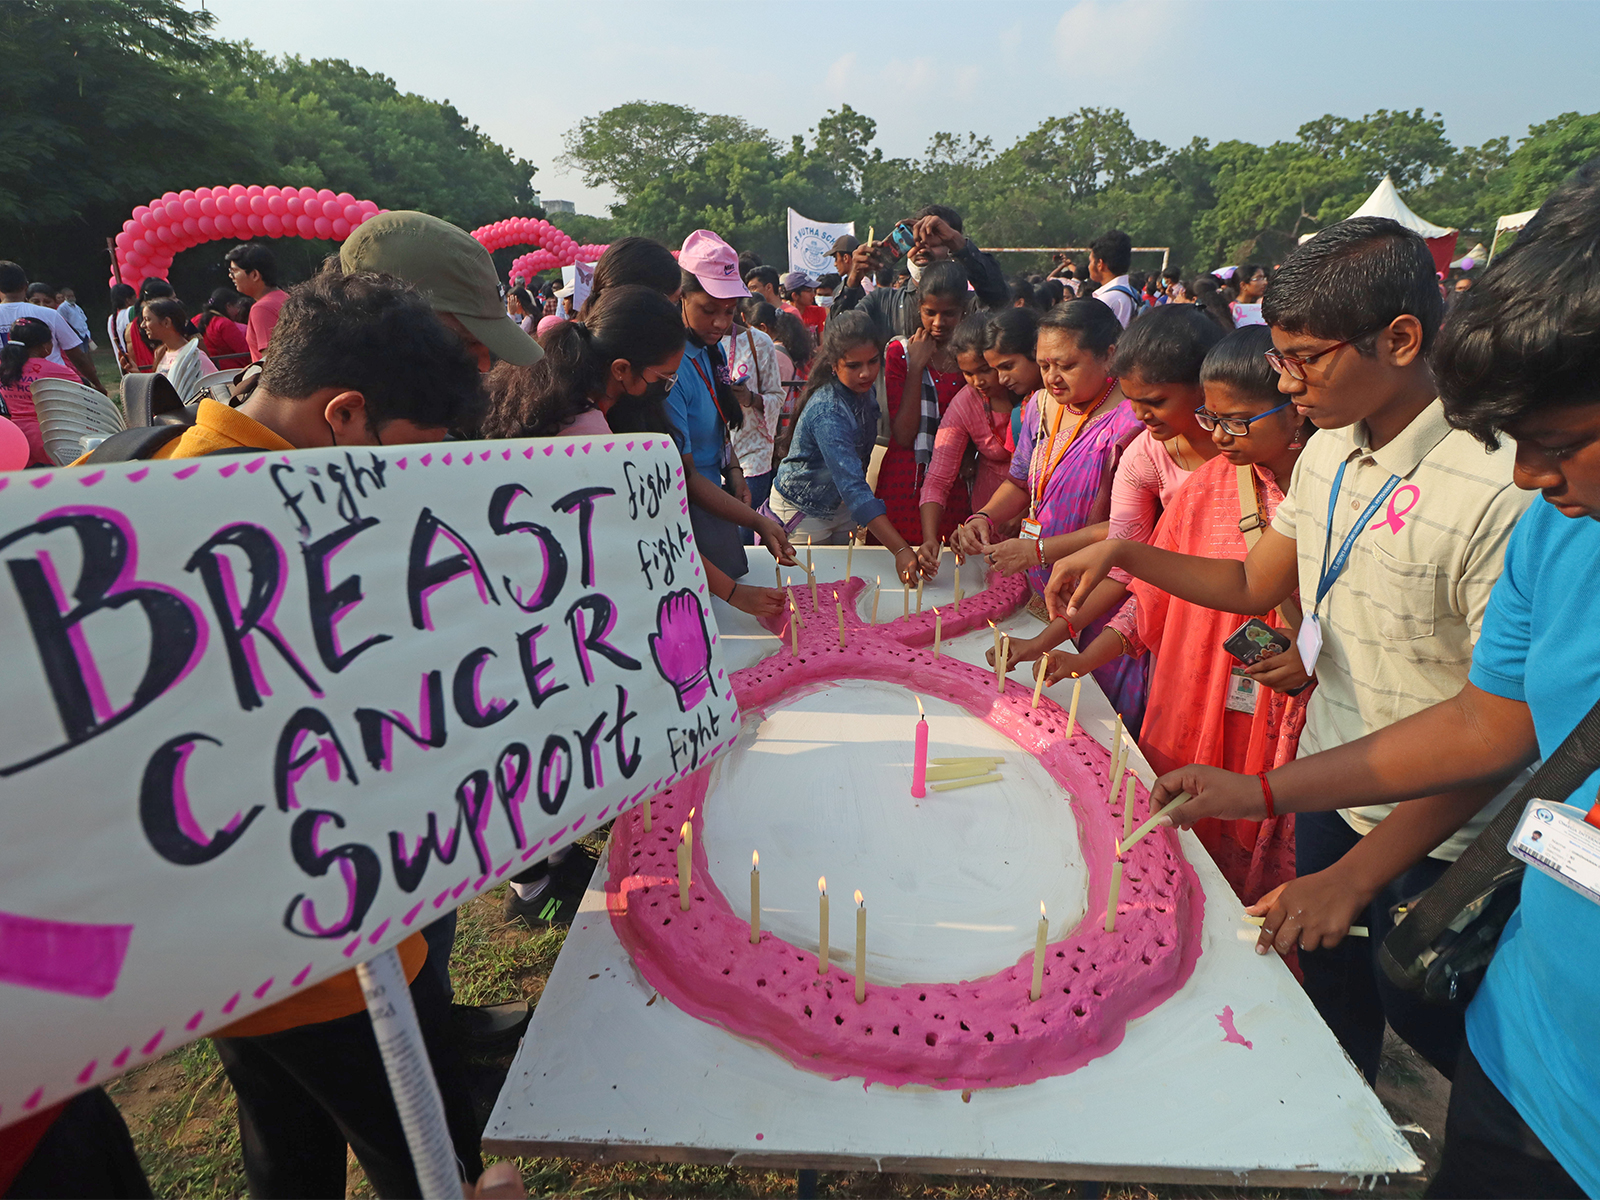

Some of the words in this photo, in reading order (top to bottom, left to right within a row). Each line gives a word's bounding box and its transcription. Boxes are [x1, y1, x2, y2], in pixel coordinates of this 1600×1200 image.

[270, 452, 386, 536] fight
[623, 461, 671, 520] fight
[637, 522, 688, 591] fight
[0, 484, 616, 776] BREAST
[139, 593, 642, 866] CANCER
[667, 705, 720, 772] Fight
[283, 685, 643, 939] Support
